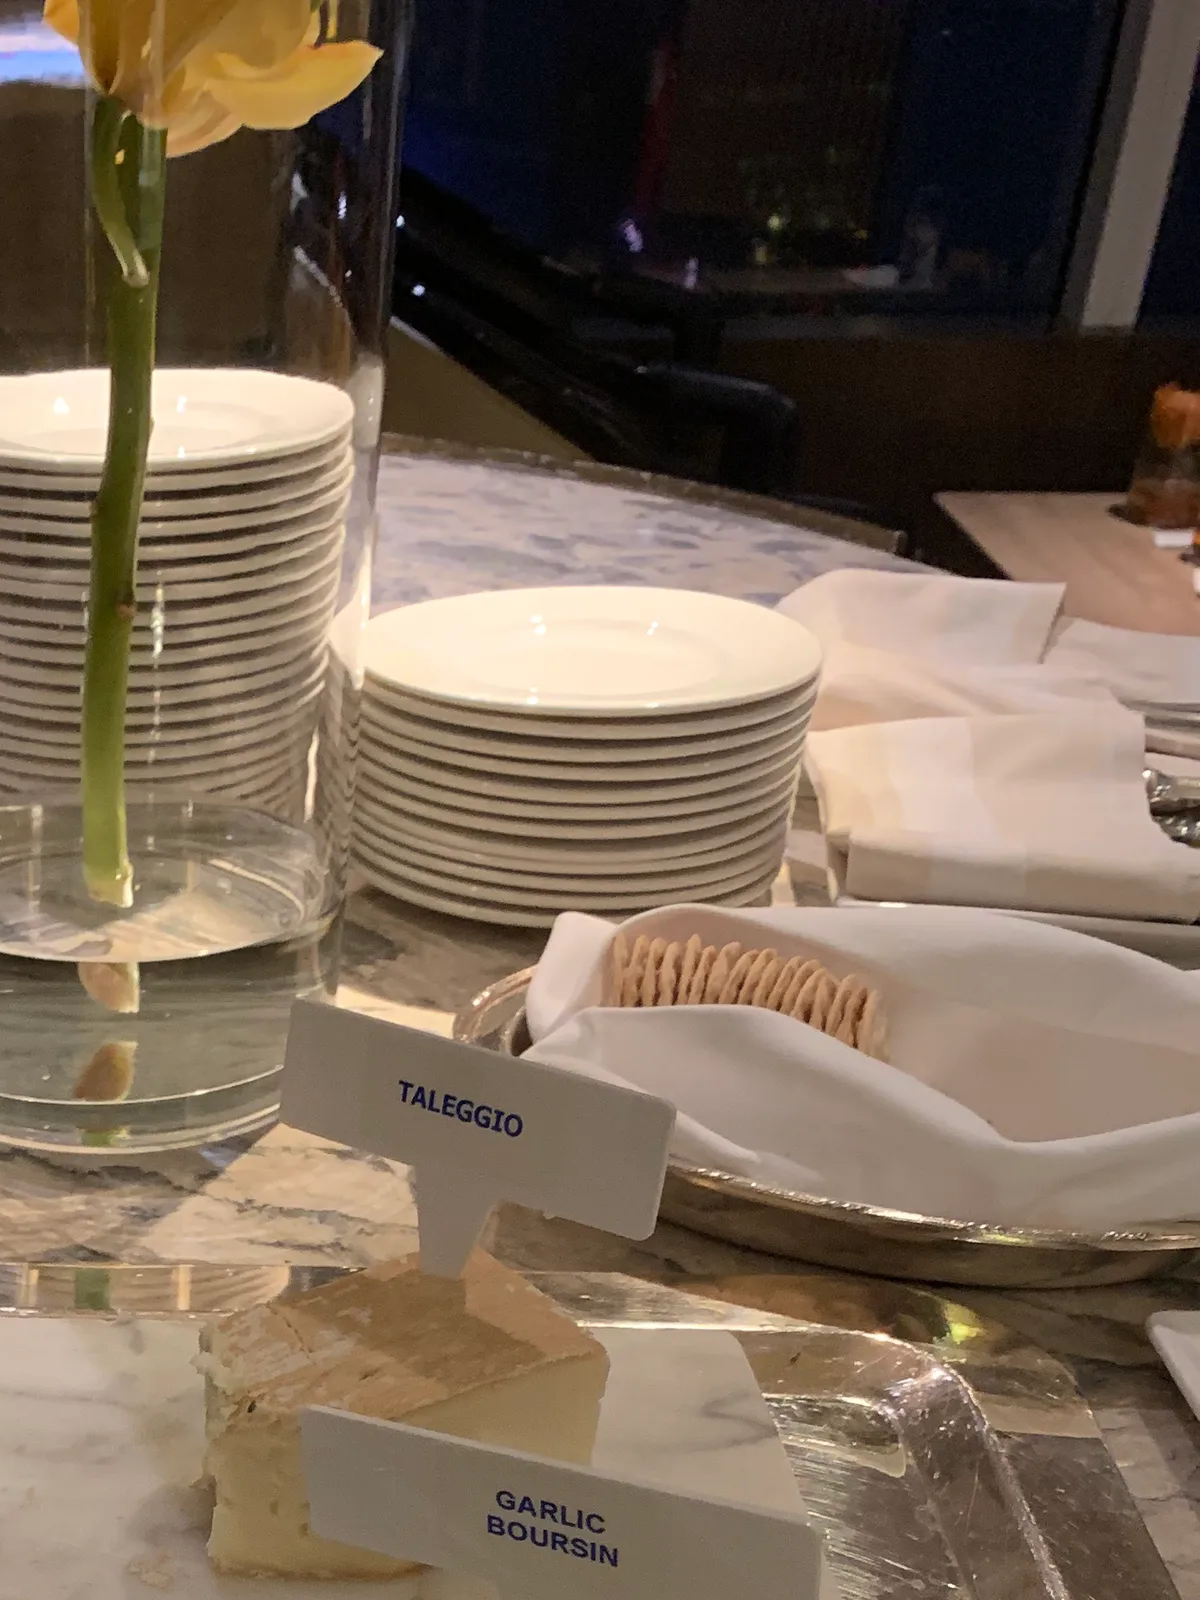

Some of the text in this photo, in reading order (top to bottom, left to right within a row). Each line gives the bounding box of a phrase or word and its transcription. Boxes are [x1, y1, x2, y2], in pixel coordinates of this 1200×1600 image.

[398, 1079, 523, 1137] TALEGGIO
[496, 1490, 606, 1534] GARLIC
[487, 1514, 619, 1568] BOURSIN
